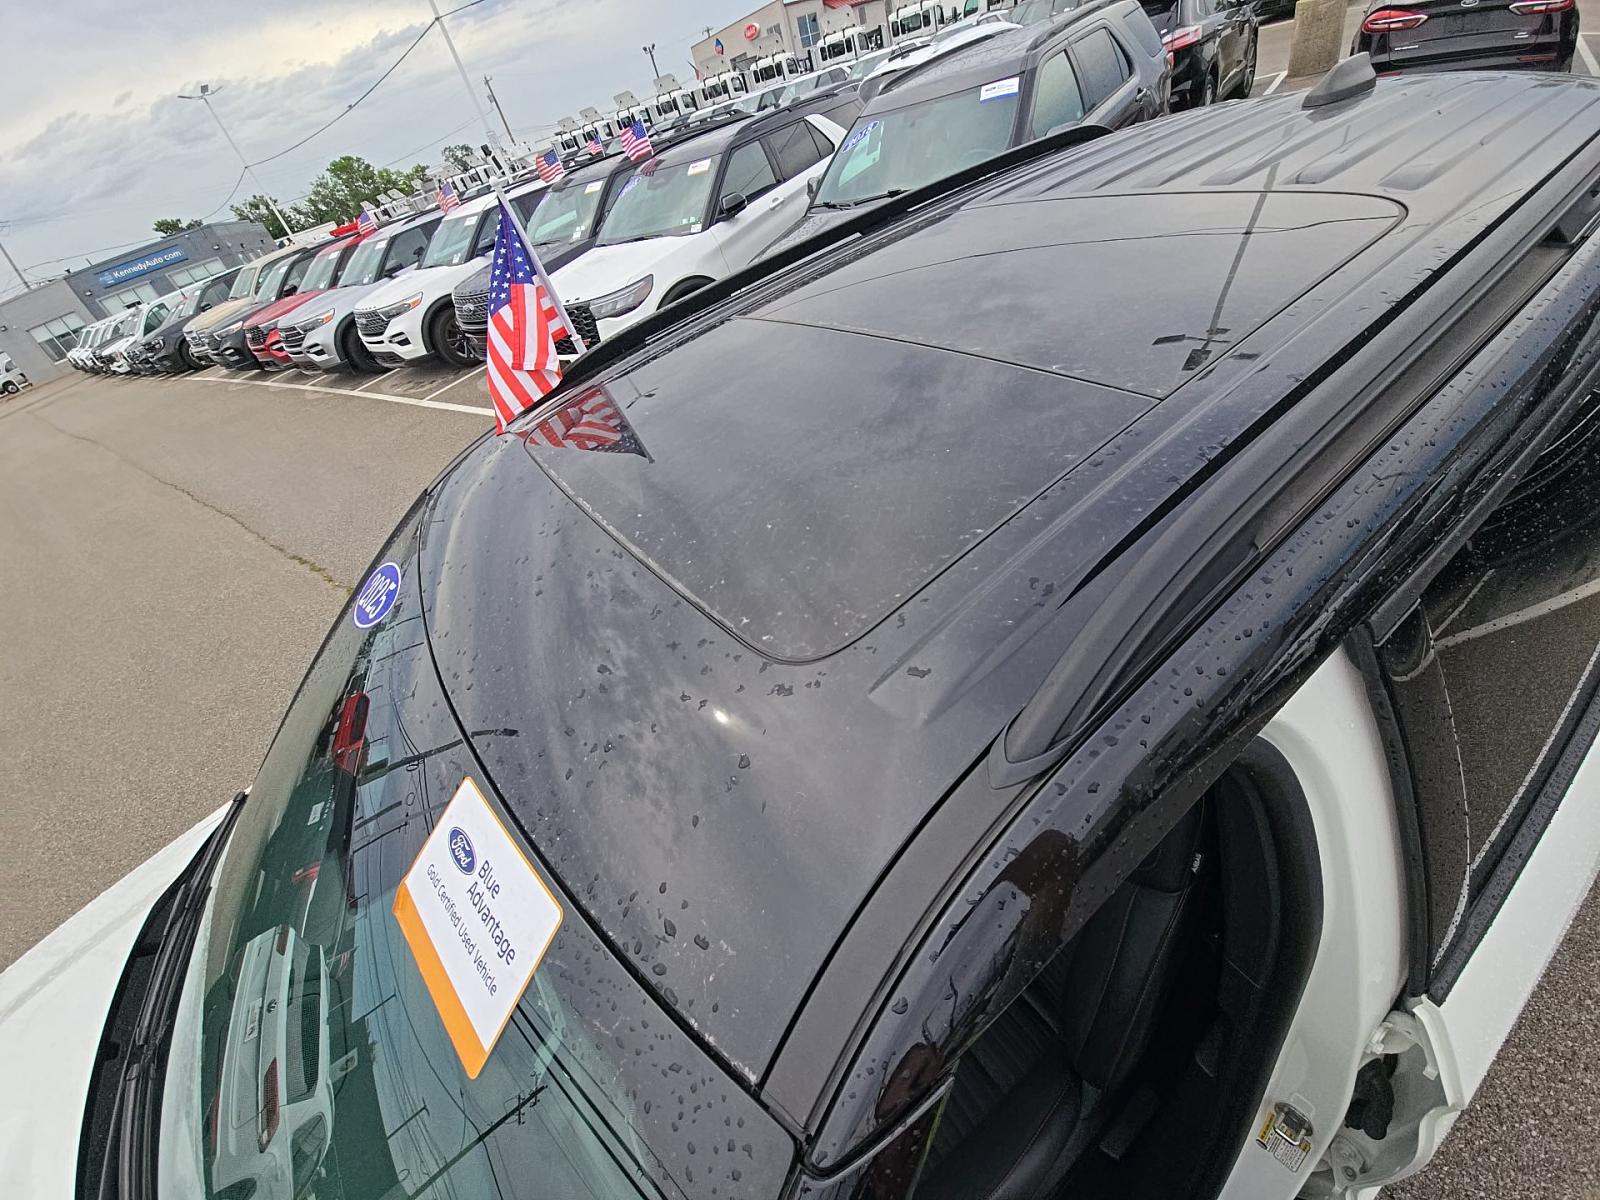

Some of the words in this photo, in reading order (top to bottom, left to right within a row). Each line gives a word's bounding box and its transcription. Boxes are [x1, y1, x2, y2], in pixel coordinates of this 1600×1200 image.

[359, 573, 397, 619] 2025
[477, 859, 501, 900] Blue
[426, 863, 441, 890] Gold
[436, 884, 461, 928] Certified
[459, 923, 475, 955] Used
[473, 950, 498, 997] Vehicle
[466, 881, 516, 966] Advantage
